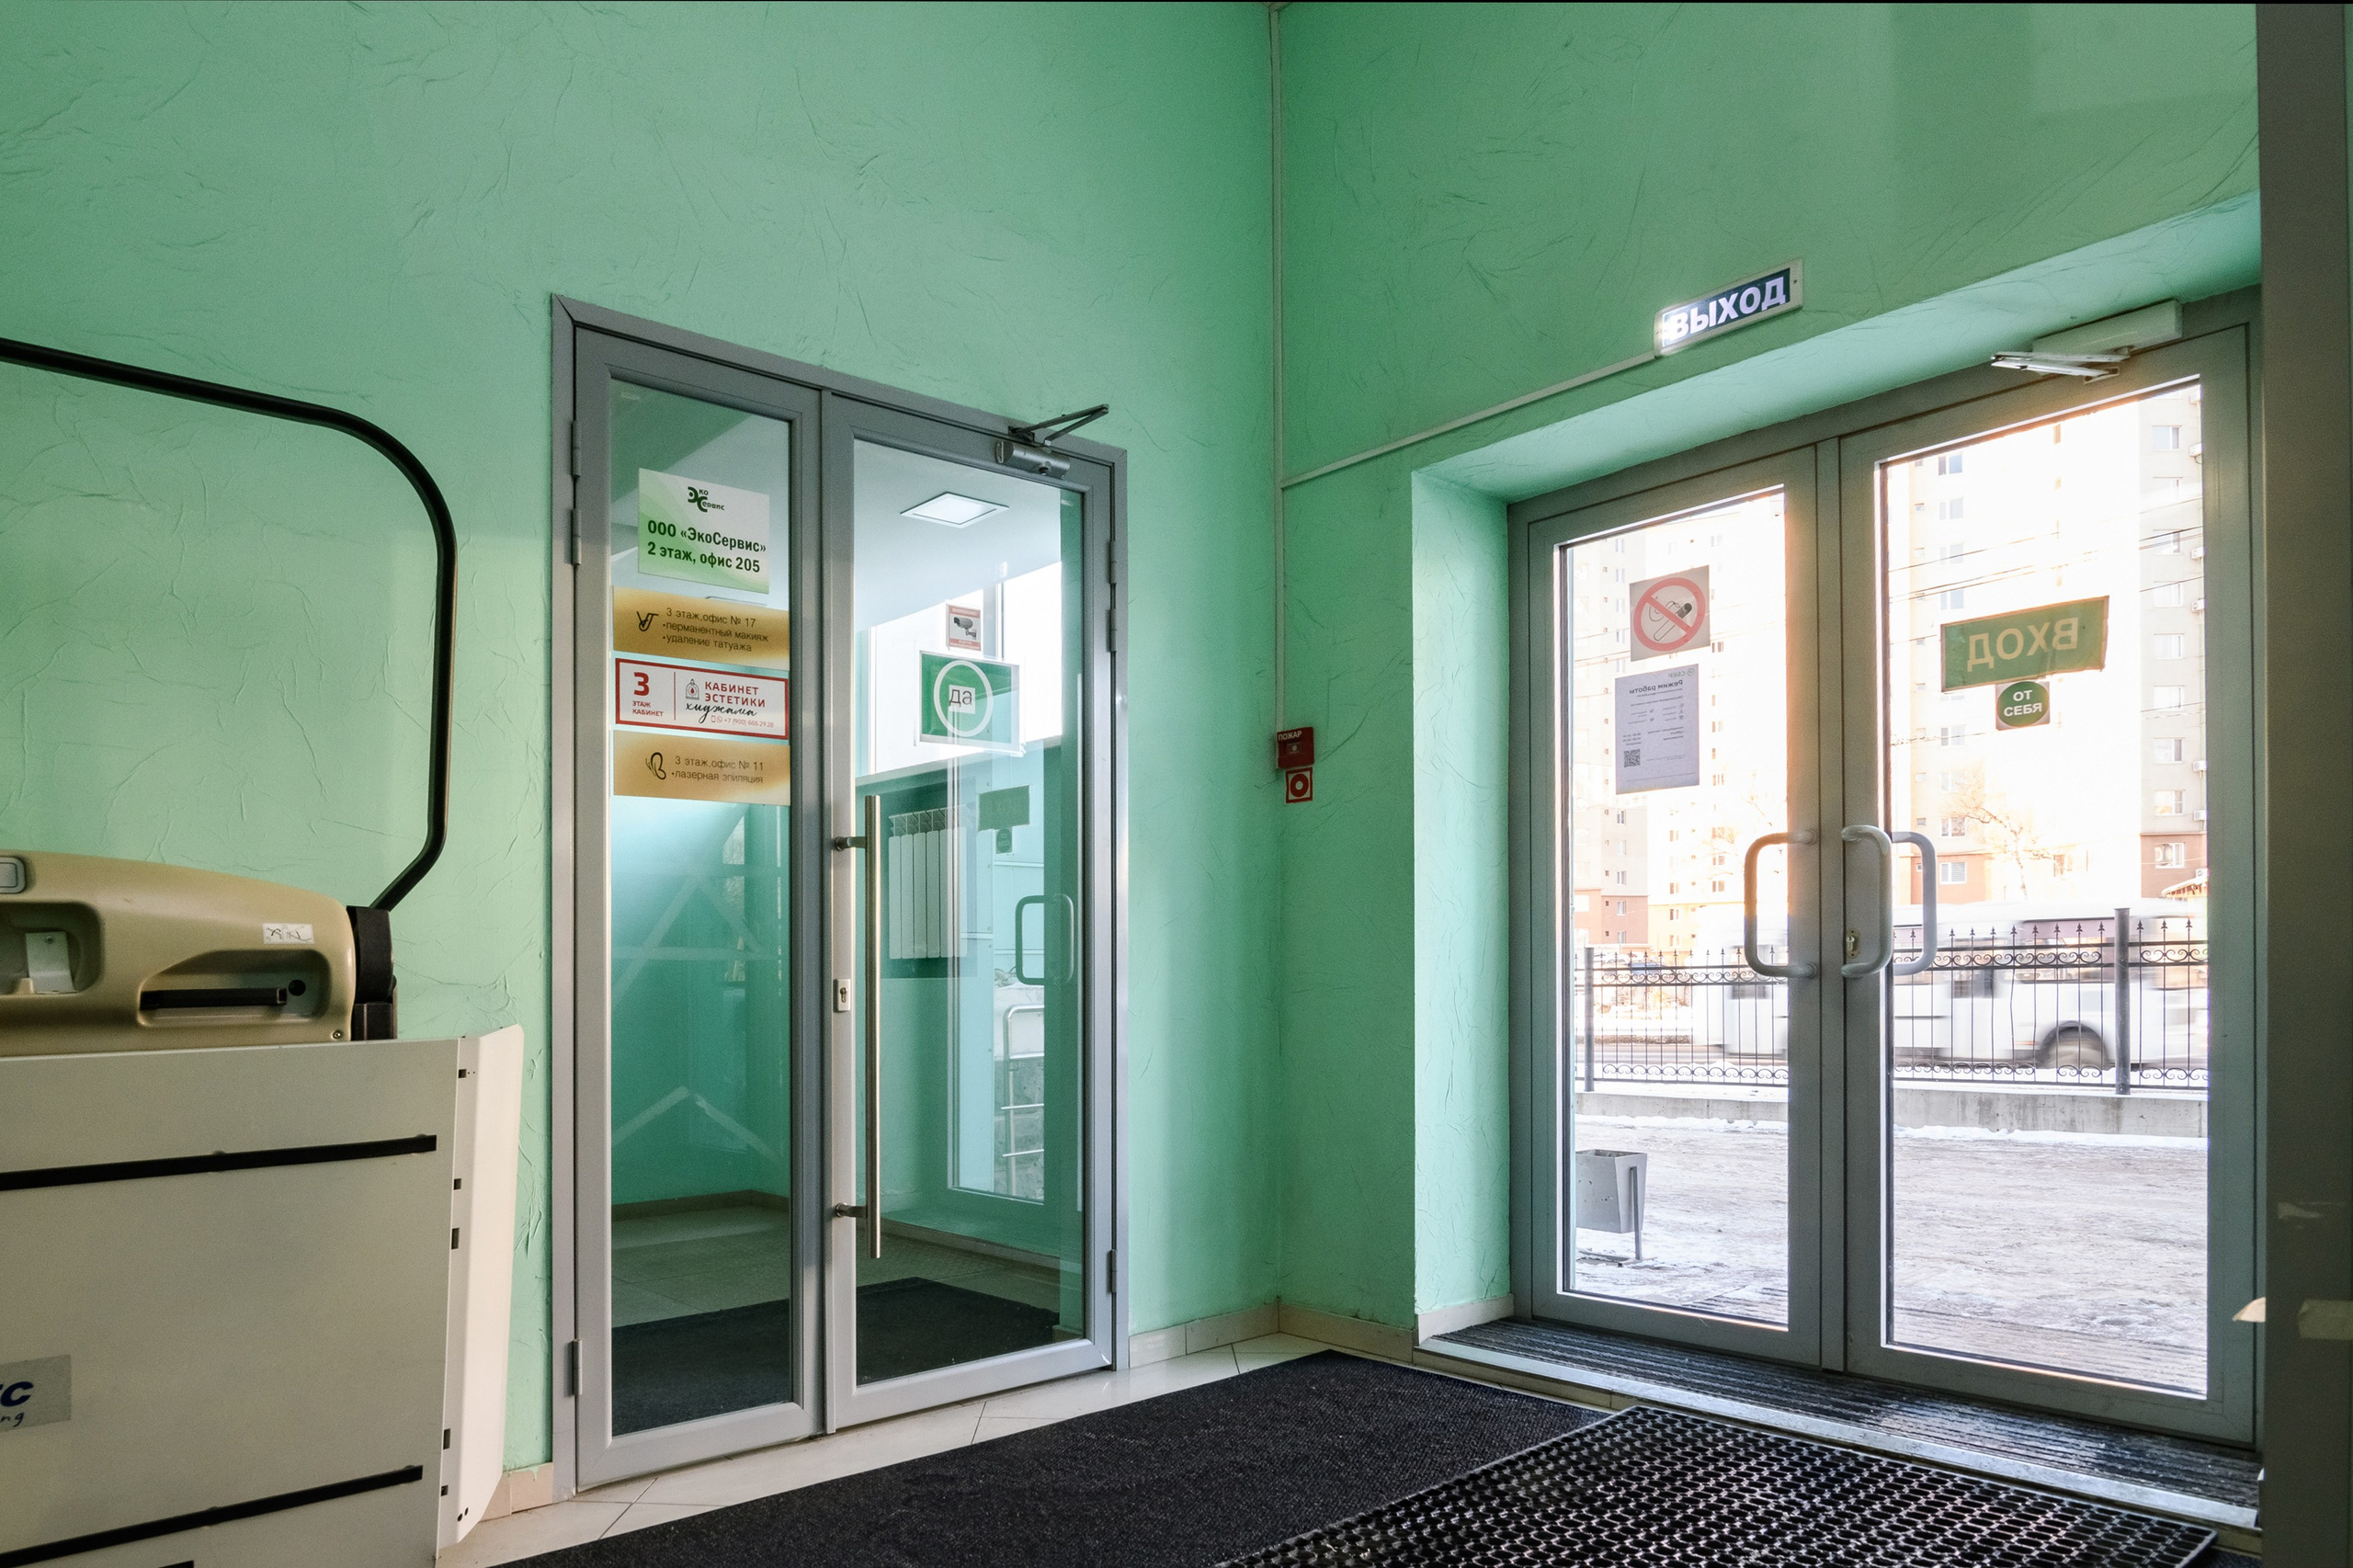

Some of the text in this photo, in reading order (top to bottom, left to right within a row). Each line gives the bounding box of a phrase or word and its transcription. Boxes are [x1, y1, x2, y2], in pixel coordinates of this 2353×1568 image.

[1668, 276, 1786, 342] ВЫХОД
[648, 519, 767, 552] ООО «ЭкоСервис»
[647, 541, 760, 573] 2 этаж, офис 205
[666, 608, 672, 617] 3
[730, 616, 741, 625] №
[745, 618, 756, 628] 17
[735, 631, 768, 642] макияж
[713, 640, 753, 652] татуажа
[633, 672, 650, 697] 3
[705, 681, 759, 696] КАБИНЕТ
[704, 693, 766, 708] ЭСТЕТИКИ
[949, 689, 972, 707] да
[2013, 689, 2032, 702] ОТ
[632, 709, 664, 717] КАБИНЕТ
[2004, 702, 2042, 717] СЕБЯ
[1278, 731, 1302, 741] ПОЖАР
[676, 756, 681, 766] 3
[739, 760, 749, 769] №
[754, 762, 764, 771] 11
[722, 772, 764, 784] эпиляция
